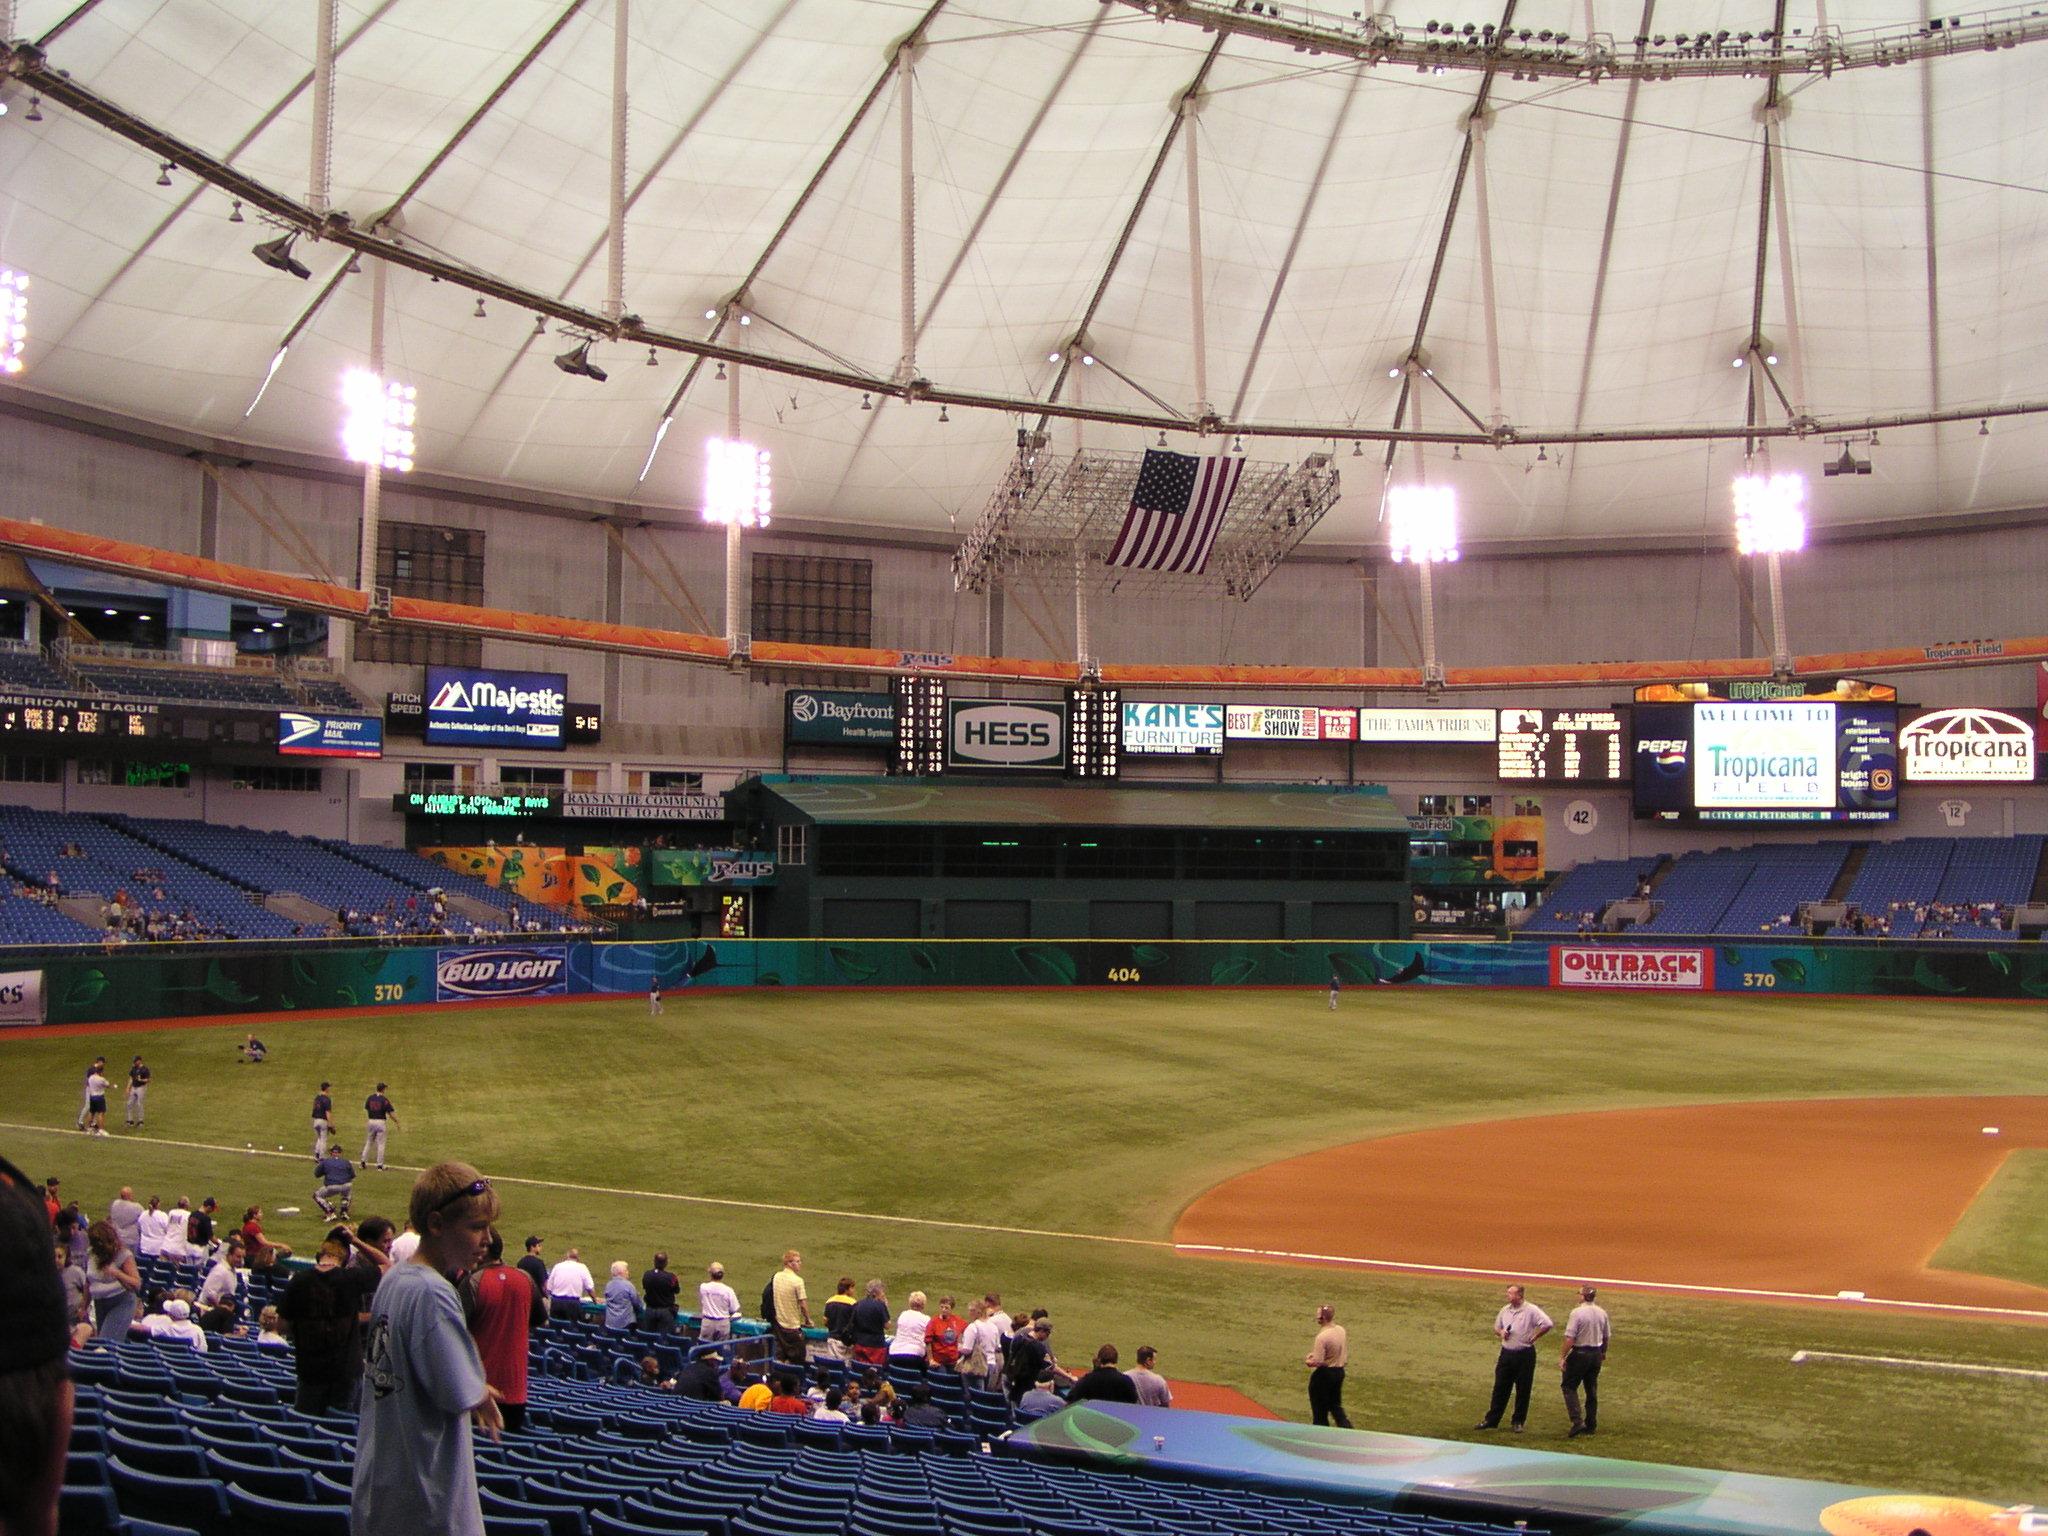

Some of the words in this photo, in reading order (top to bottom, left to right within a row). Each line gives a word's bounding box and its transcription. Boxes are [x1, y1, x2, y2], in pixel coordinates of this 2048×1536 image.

[1925, 647, 1971, 659] Tropicana
[1976, 644, 2001, 655] Field
[392, 693, 421, 703] PITCH
[472, 682, 564, 714] Majestic
[0, 696, 78, 709] MERICAN
[91, 702, 159, 714] LEAGUE
[390, 704, 422, 715] SPEED
[822, 701, 894, 721] Bayfront
[1124, 704, 1223, 728] KANE'S
[1265, 709, 1300, 720] SPORTS
[325, 720, 362, 731] PRIORITY
[1227, 713, 1251, 730] BEST
[1367, 718, 1392, 731] THE
[1396, 718, 1434, 731] TAMPA
[1437, 718, 1491, 731] TRIBUNE
[324, 730, 343, 738] MAIL
[842, 727, 866, 737] Health
[867, 728, 893, 739] System
[965, 721, 1050, 747] HESS
[1265, 721, 1300, 737] SHOW
[1124, 730, 1223, 745] FURNITURE
[1637, 740, 1687, 753] PEPSI
[1907, 732, 2027, 760] Tropicana
[1707, 745, 1818, 783] Tropicana
[1841, 771, 1868, 781] bright
[1713, 782, 1818, 793] FIELD
[1841, 779, 1869, 788] house
[410, 794, 423, 805] ON
[428, 795, 464, 806] AUGUST
[503, 797, 521, 807] THE
[568, 793, 600, 804] RAYS
[602, 794, 615, 804] IN
[617, 795, 644, 805] THE
[645, 796, 720, 808] COMMUNITY
[568, 807, 576, 815] A
[581, 807, 629, 817] TRIBUTE
[637, 808, 651, 818] TO
[656, 808, 685, 819] JACK
[688, 809, 720, 819] LAKE
[1572, 811, 1589, 823] 42
[1711, 811, 1732, 820] CITY
[1734, 811, 1745, 820] OF
[1760, 811, 1814, 820] PETERSBURG
[1849, 812, 1889, 820] MITSUBISHI
[1951, 807, 1960, 818] 12
[1427, 818, 1451, 830] Field
[1564, 952, 1697, 973] OUTBACK
[444, 962, 495, 982] BUD
[496, 960, 561, 980] LIGHT
[1108, 968, 1140, 982] 404
[1585, 971, 1678, 982] STEAKHOUSE
[1743, 973, 1776, 987] 370
[375, 984, 403, 1001] 370
